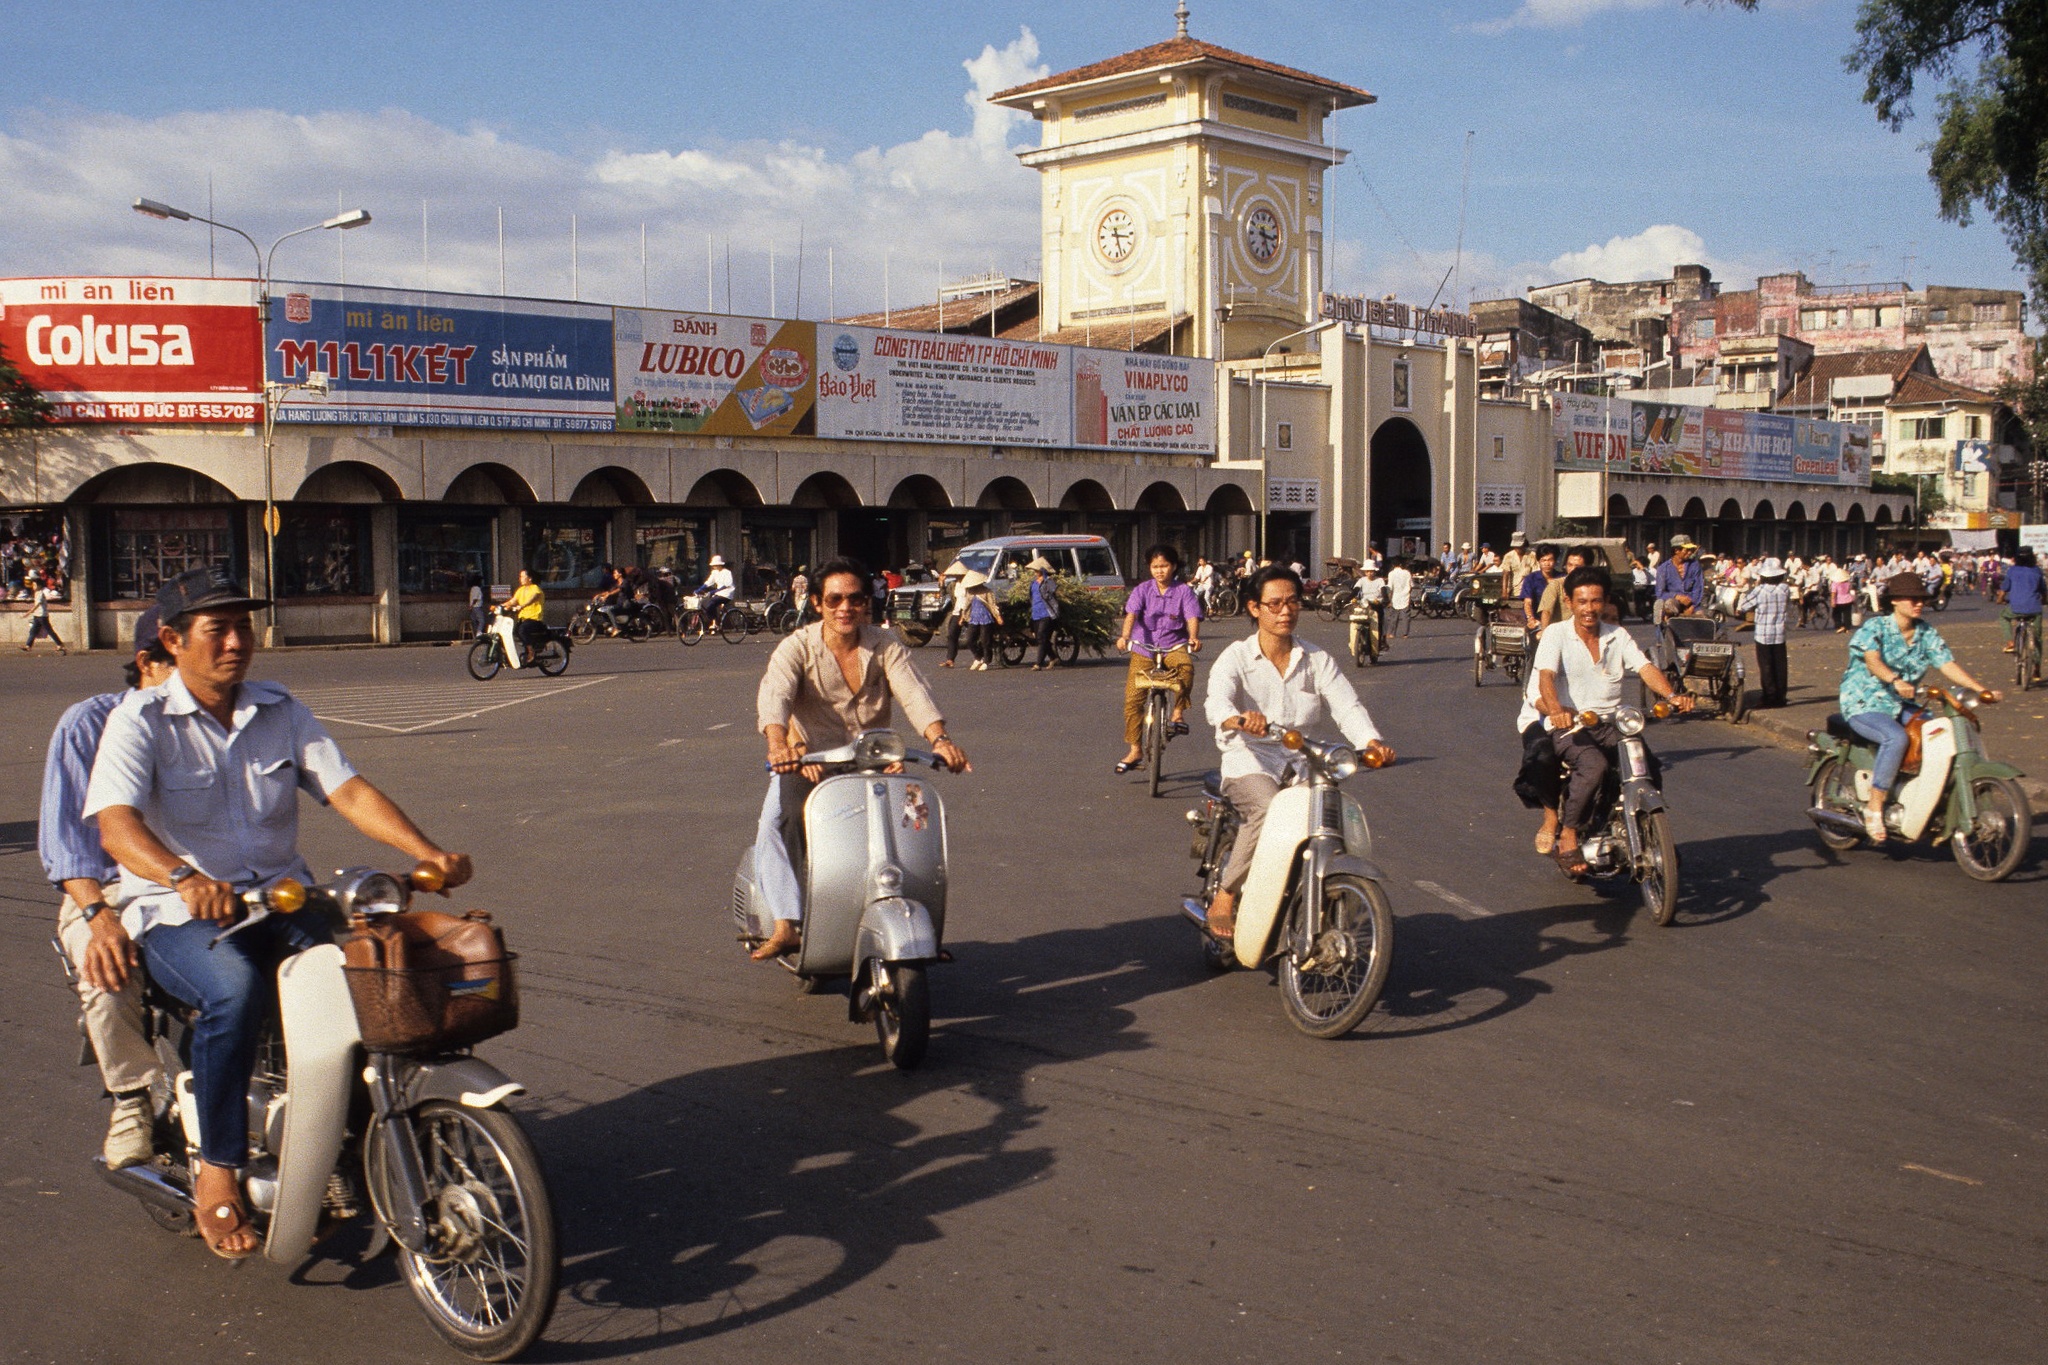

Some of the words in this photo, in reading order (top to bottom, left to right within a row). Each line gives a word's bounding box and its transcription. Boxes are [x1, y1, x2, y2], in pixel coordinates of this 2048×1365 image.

[673, 316, 718, 336] BÁNH
[26, 314, 195, 366] Colusa
[873, 334, 907, 358] CÔNG
[909, 339, 922, 360] TY
[922, 336, 945, 361] BẢO
[948, 338, 974, 363] HIỂM
[977, 345, 992, 364] TP
[993, 343, 1010, 366] HỒ
[1010, 345, 1034, 368] CHÍ
[1031, 351, 1059, 369] MINH
[275, 338, 478, 386] MILIKET
[491, 343, 521, 366] SẢN
[524, 344, 568, 369] PHẨM
[639, 342, 746, 379] LUBICO
[491, 365, 519, 388] CỦA
[521, 373, 547, 392] MỌI
[550, 374, 574, 391] GIA
[575, 374, 610, 392] ĐÌNH
[818, 370, 847, 400] Bảo
[847, 371, 877, 404] Việt
[889, 370, 923, 378] UNDERWRITES
[1013, 378, 1036, 386] REQUESTS
[1125, 371, 1189, 392] VINAPLYCO
[1111, 403, 1136, 422] VÁN
[1154, 400, 1173, 420] CÁC
[1176, 401, 1201, 421] LOẠI
[1118, 424, 1141, 439] CHẤT
[1175, 424, 1194, 435] CAO
[1573, 431, 1628, 461] VIFON
